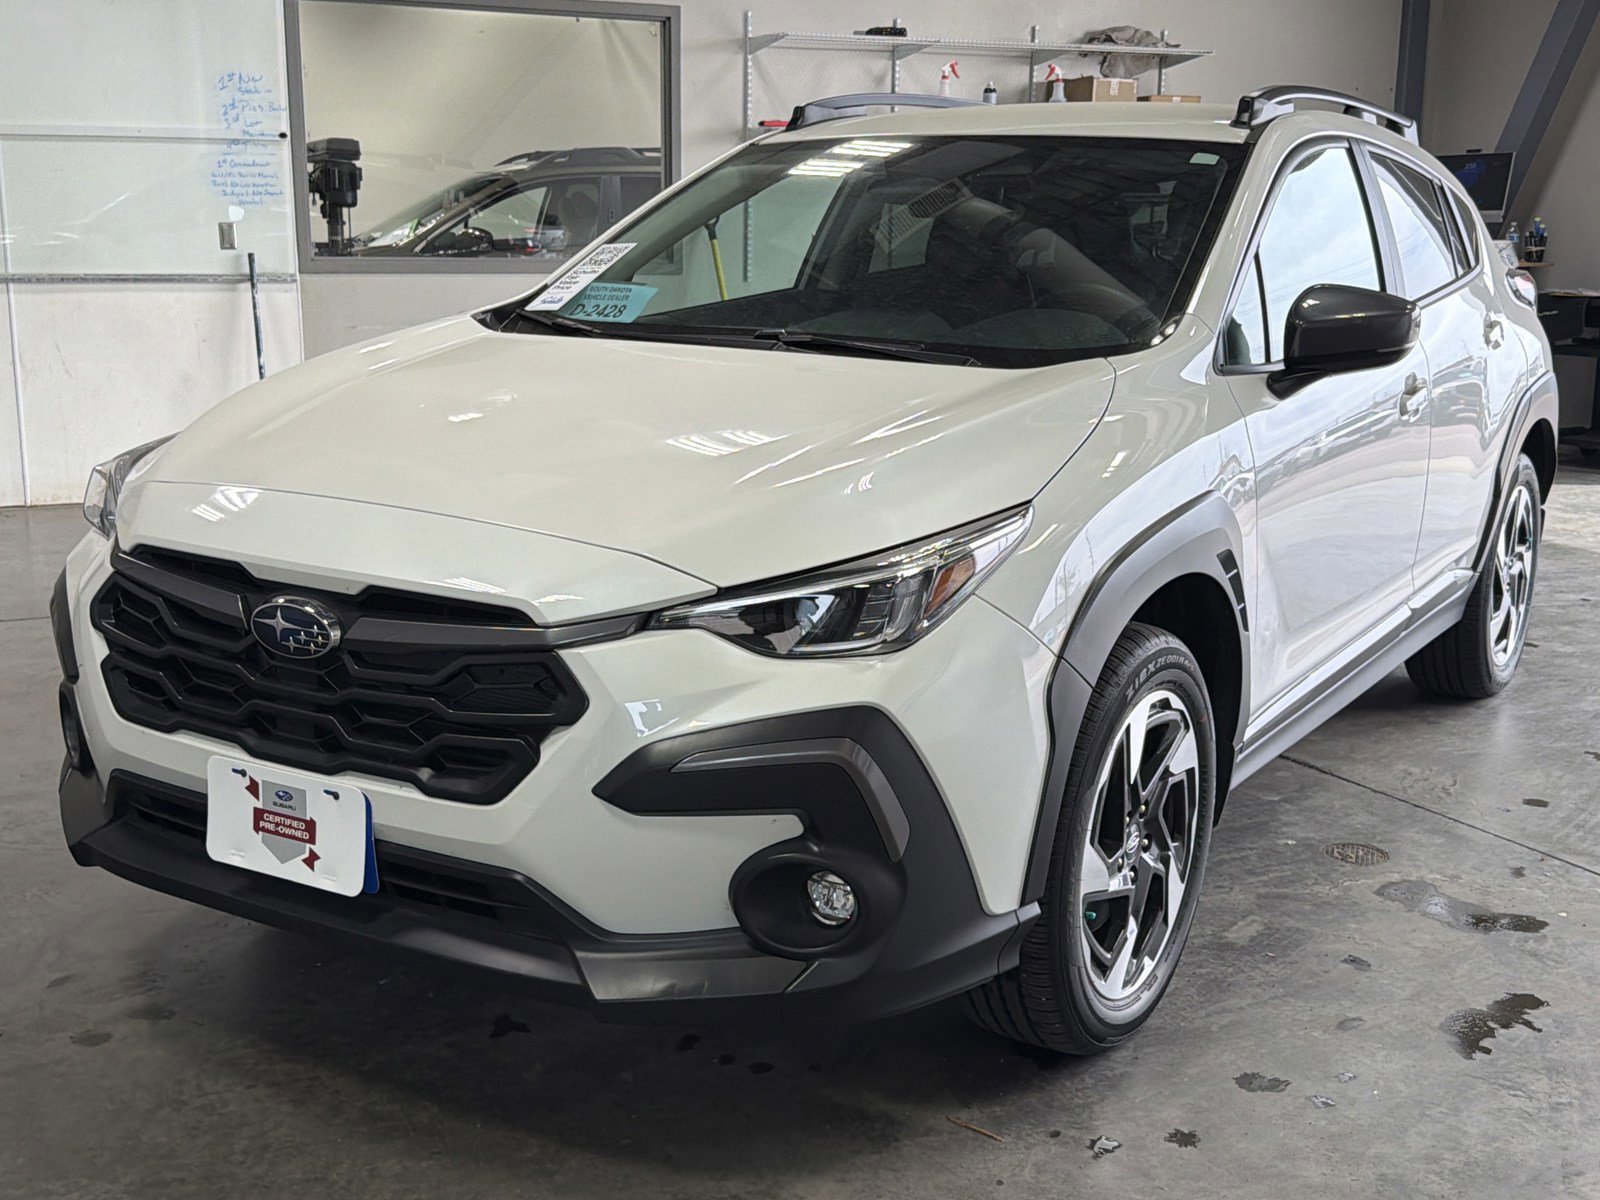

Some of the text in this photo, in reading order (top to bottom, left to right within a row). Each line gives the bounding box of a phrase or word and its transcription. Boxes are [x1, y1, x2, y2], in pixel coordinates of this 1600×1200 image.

[584, 293, 606, 301] VEHICLE
[589, 285, 633, 294] SOUTH DAKOTA
[567, 303, 628, 319] D-2428
[1126, 660, 1156, 702] ZIEX
[272, 801, 296, 811] SUBARU
[263, 812, 306, 830] CERTIFIED
[259, 820, 310, 840] PRE-OWNED
